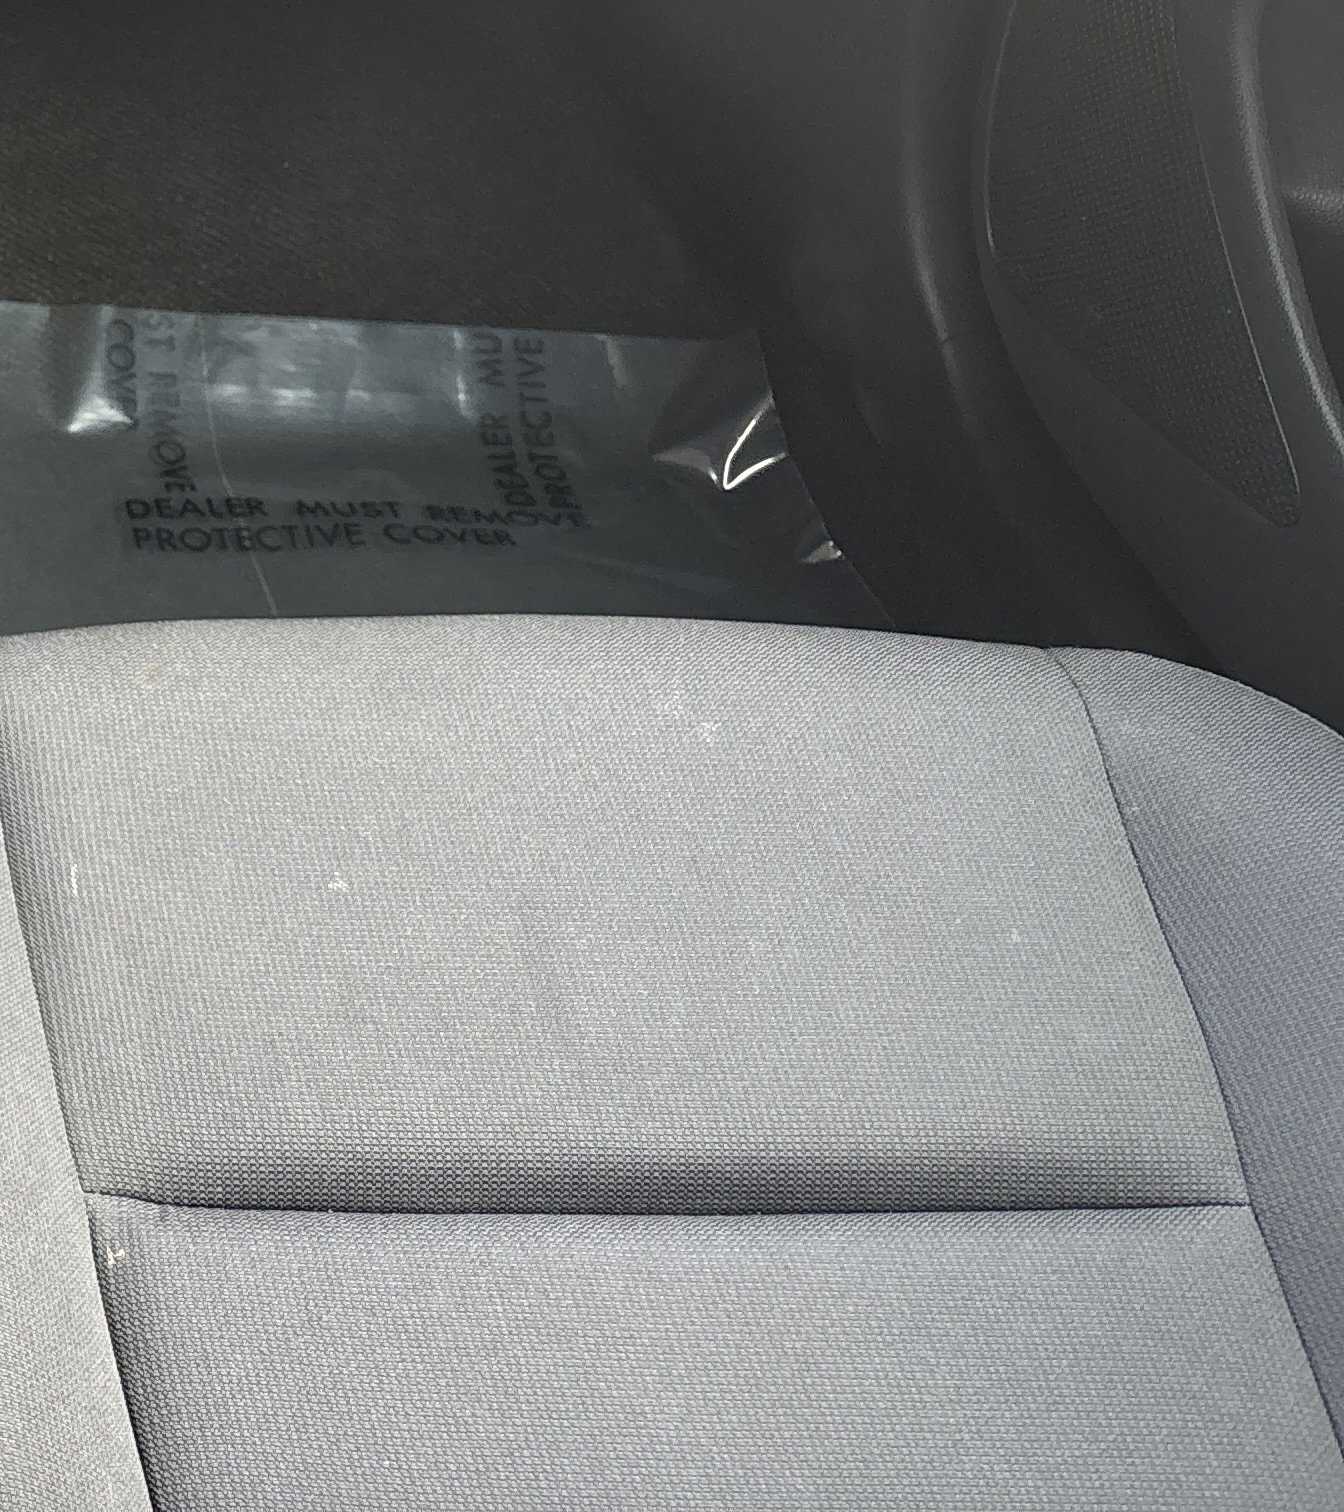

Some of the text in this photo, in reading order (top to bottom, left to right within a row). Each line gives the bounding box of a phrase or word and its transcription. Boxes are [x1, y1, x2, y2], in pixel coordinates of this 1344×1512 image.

[125, 495, 593, 530] DEALER MUST REMOVE
[132, 522, 518, 553] PROTECTIVE COVER
